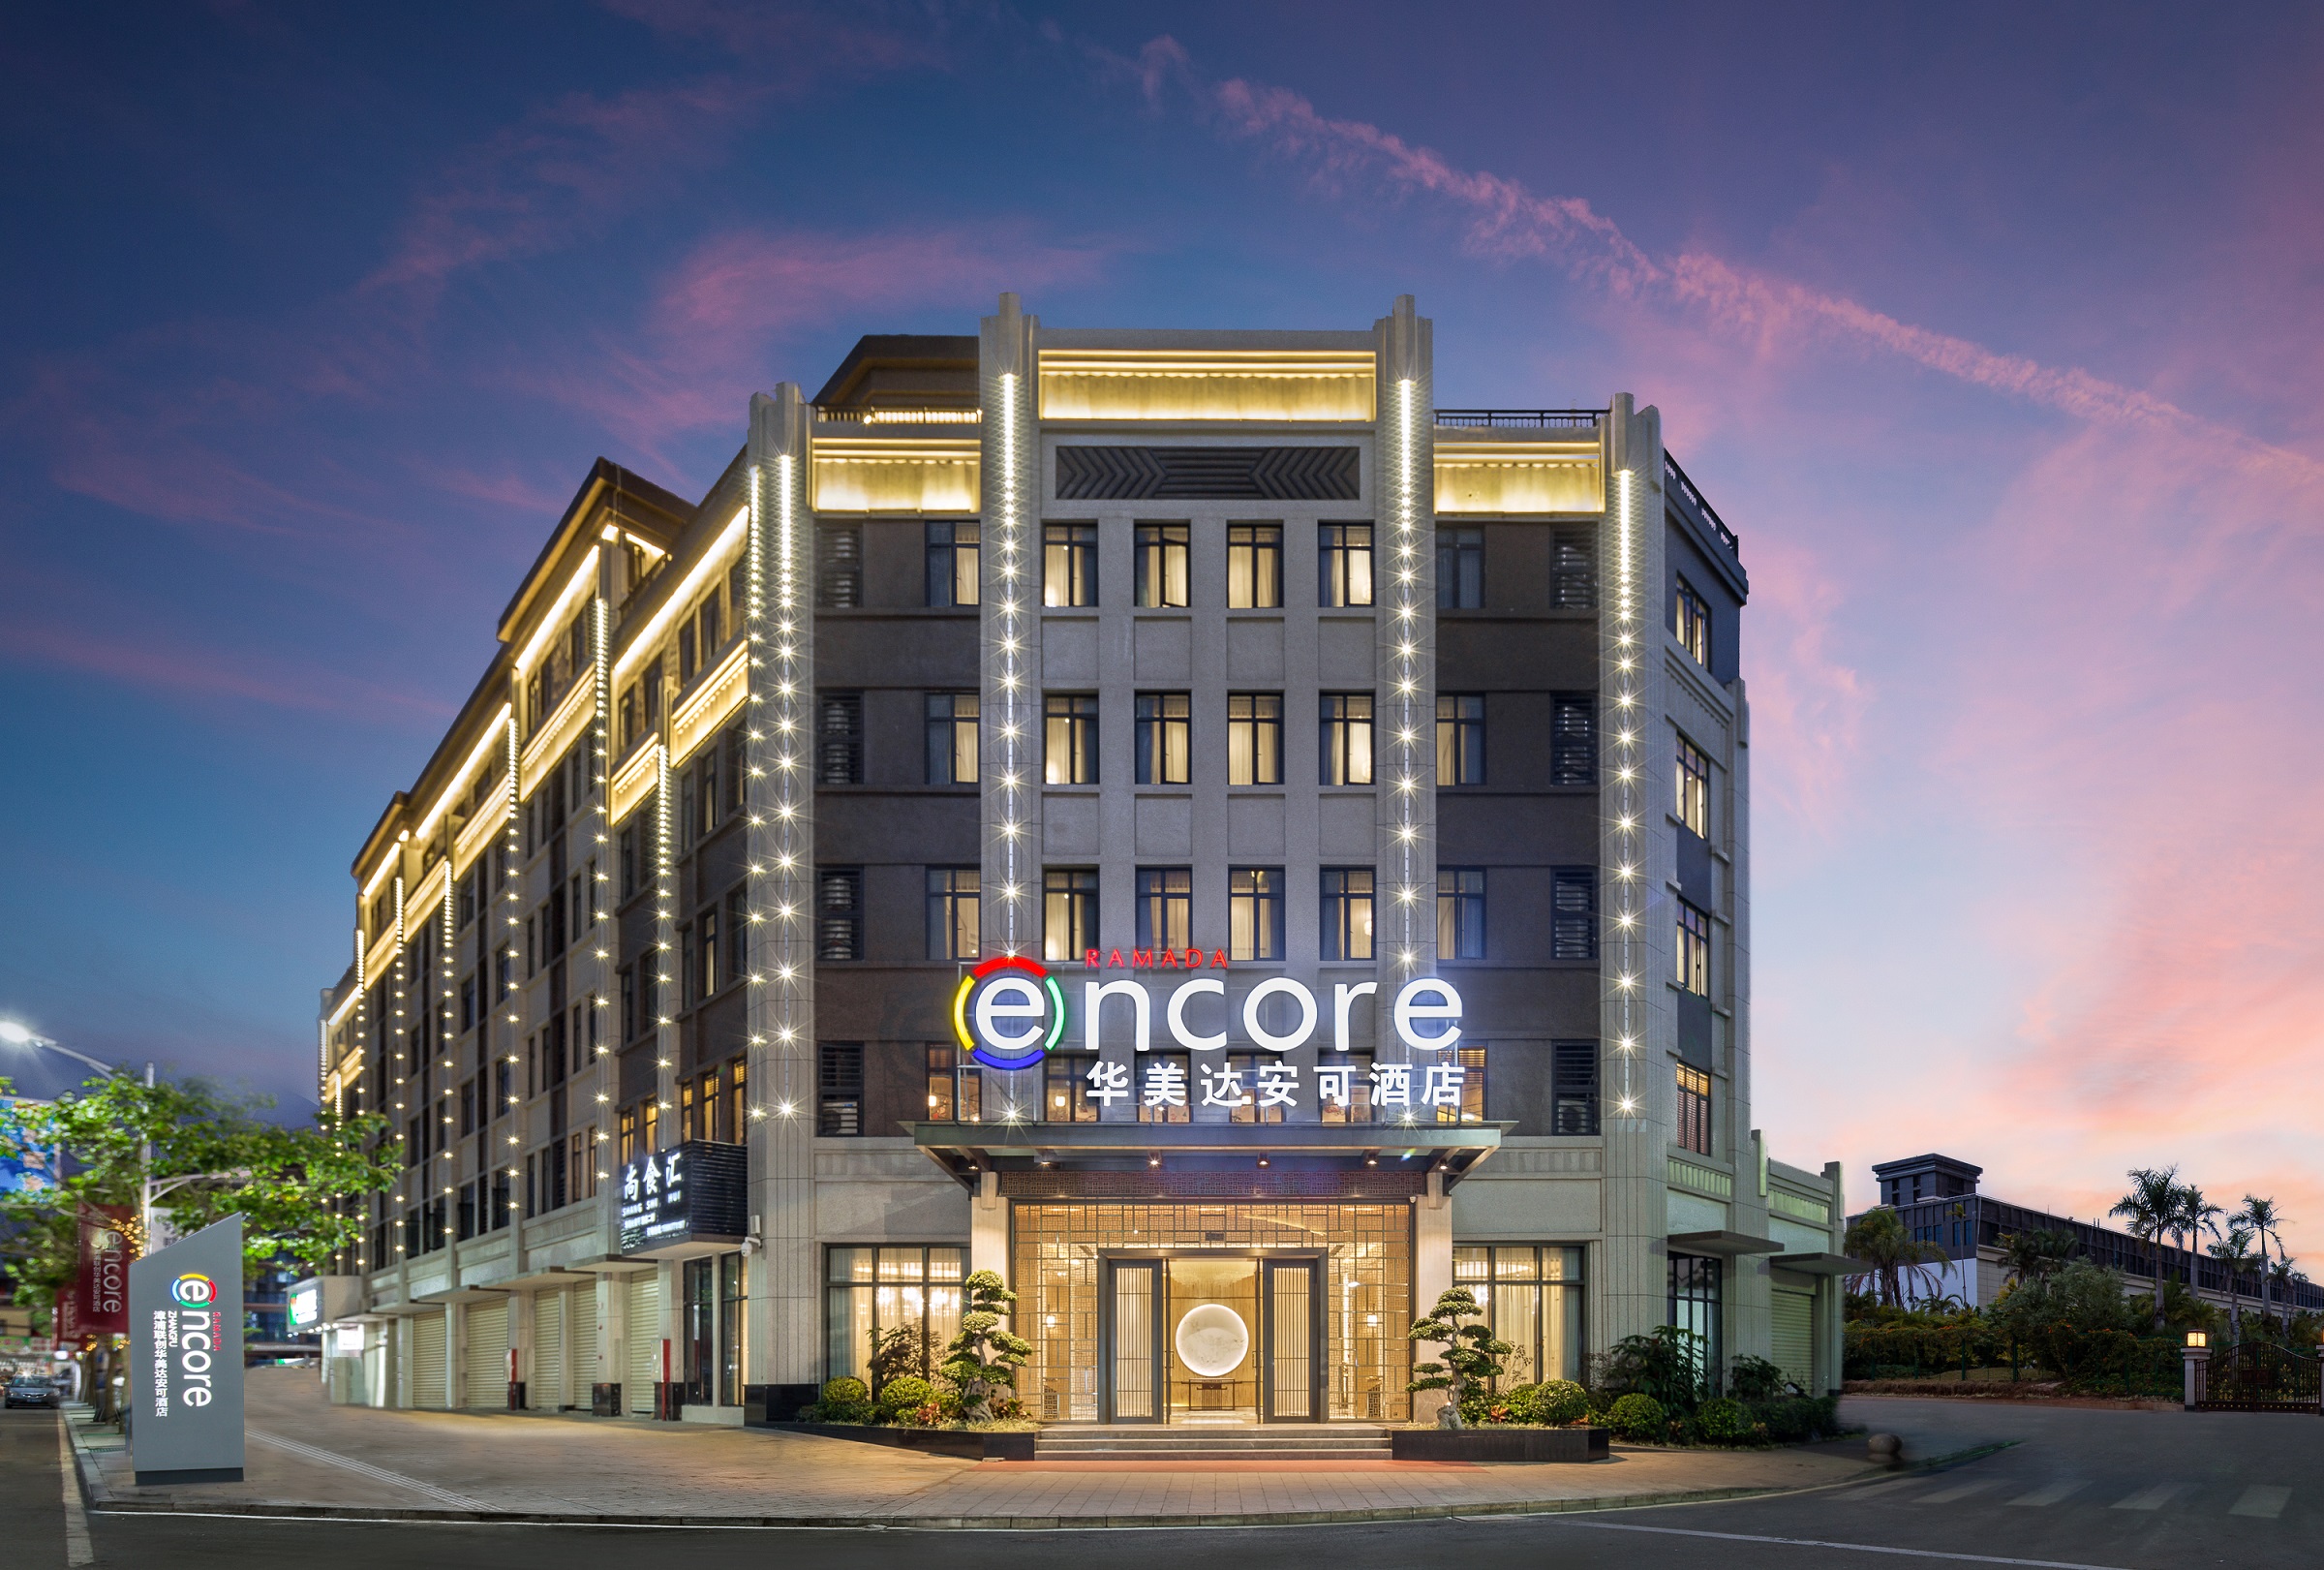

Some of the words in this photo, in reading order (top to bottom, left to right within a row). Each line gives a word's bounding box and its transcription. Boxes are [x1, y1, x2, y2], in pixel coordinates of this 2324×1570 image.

[1085, 948, 1229, 969] RAMADA
[975, 976, 1463, 1052] encore
[1086, 1061, 1466, 1107] 华美达安可酒店
[625, 1152, 682, 1201] 尚食汇
[179, 1279, 212, 1407] encore
[212, 1311, 222, 1352] RAMADA
